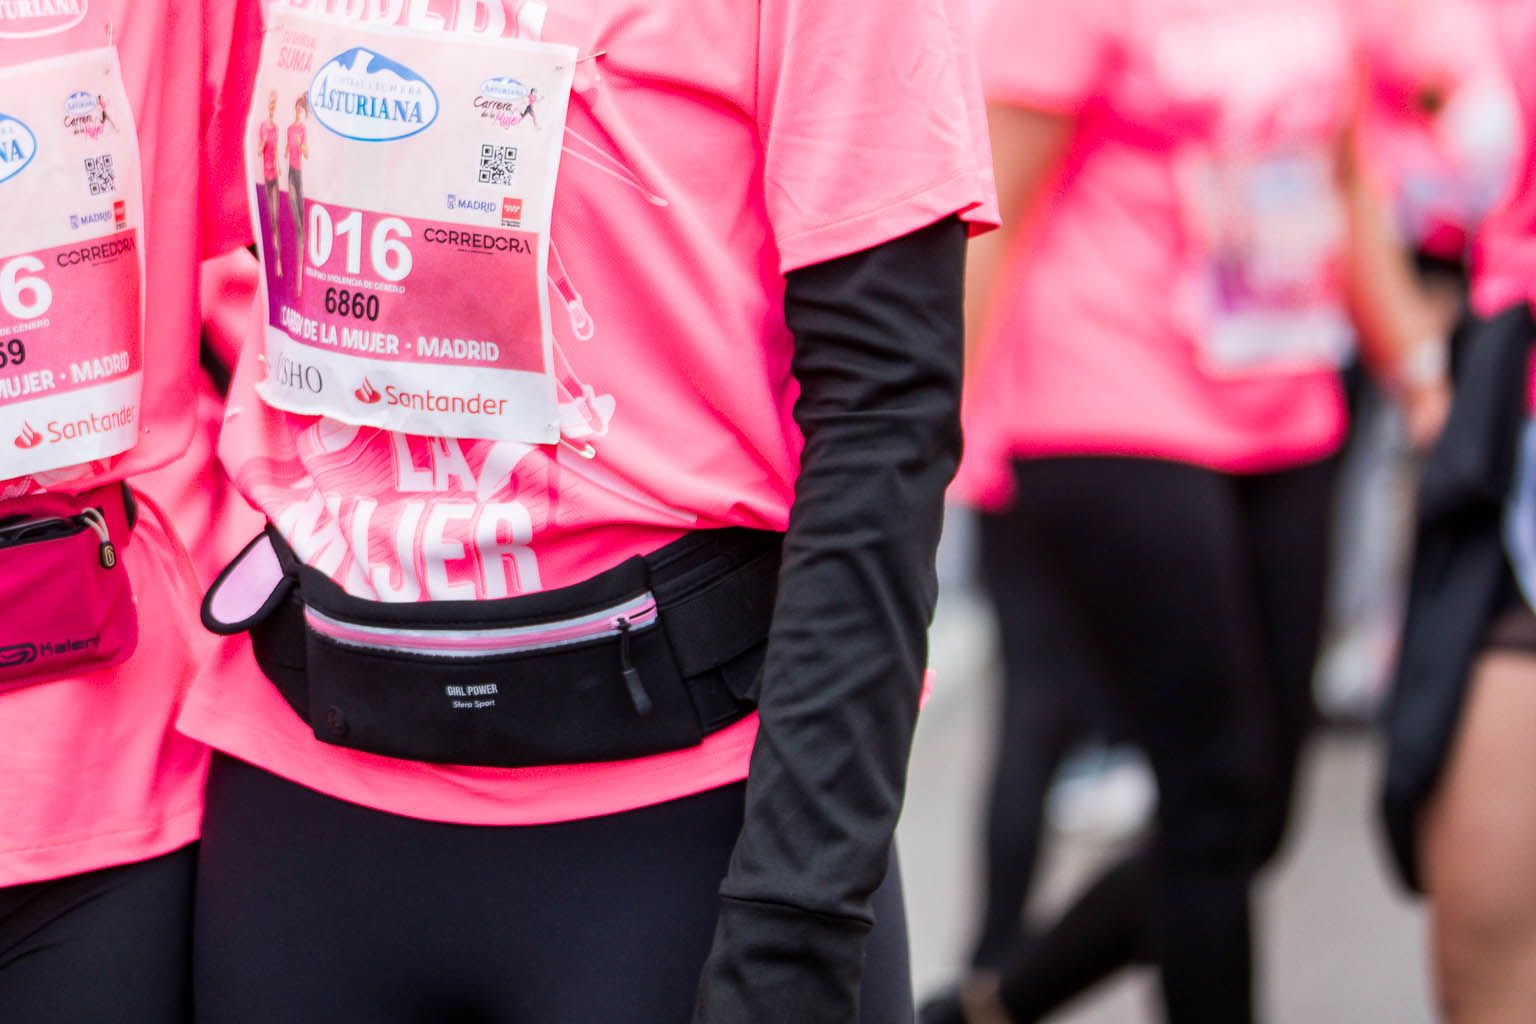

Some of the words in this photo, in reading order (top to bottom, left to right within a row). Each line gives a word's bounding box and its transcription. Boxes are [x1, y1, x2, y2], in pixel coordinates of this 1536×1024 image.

[315, 74, 424, 124] ASTURIANA
[458, 199, 496, 213] MADRID
[308, 204, 413, 282] 016
[424, 228, 531, 254] CORREDORA
[325, 287, 379, 321] 6860
[304, 319, 318, 342] DE
[319, 323, 338, 346] LA
[341, 328, 400, 355] MUJER
[417, 336, 500, 362] MADRID
[70, 352, 131, 384] MADRID
[385, 385, 509, 416] Santander
[47, 404, 136, 444] Santander
[447, 685, 466, 696] GIRL
[466, 683, 498, 695] POWER
